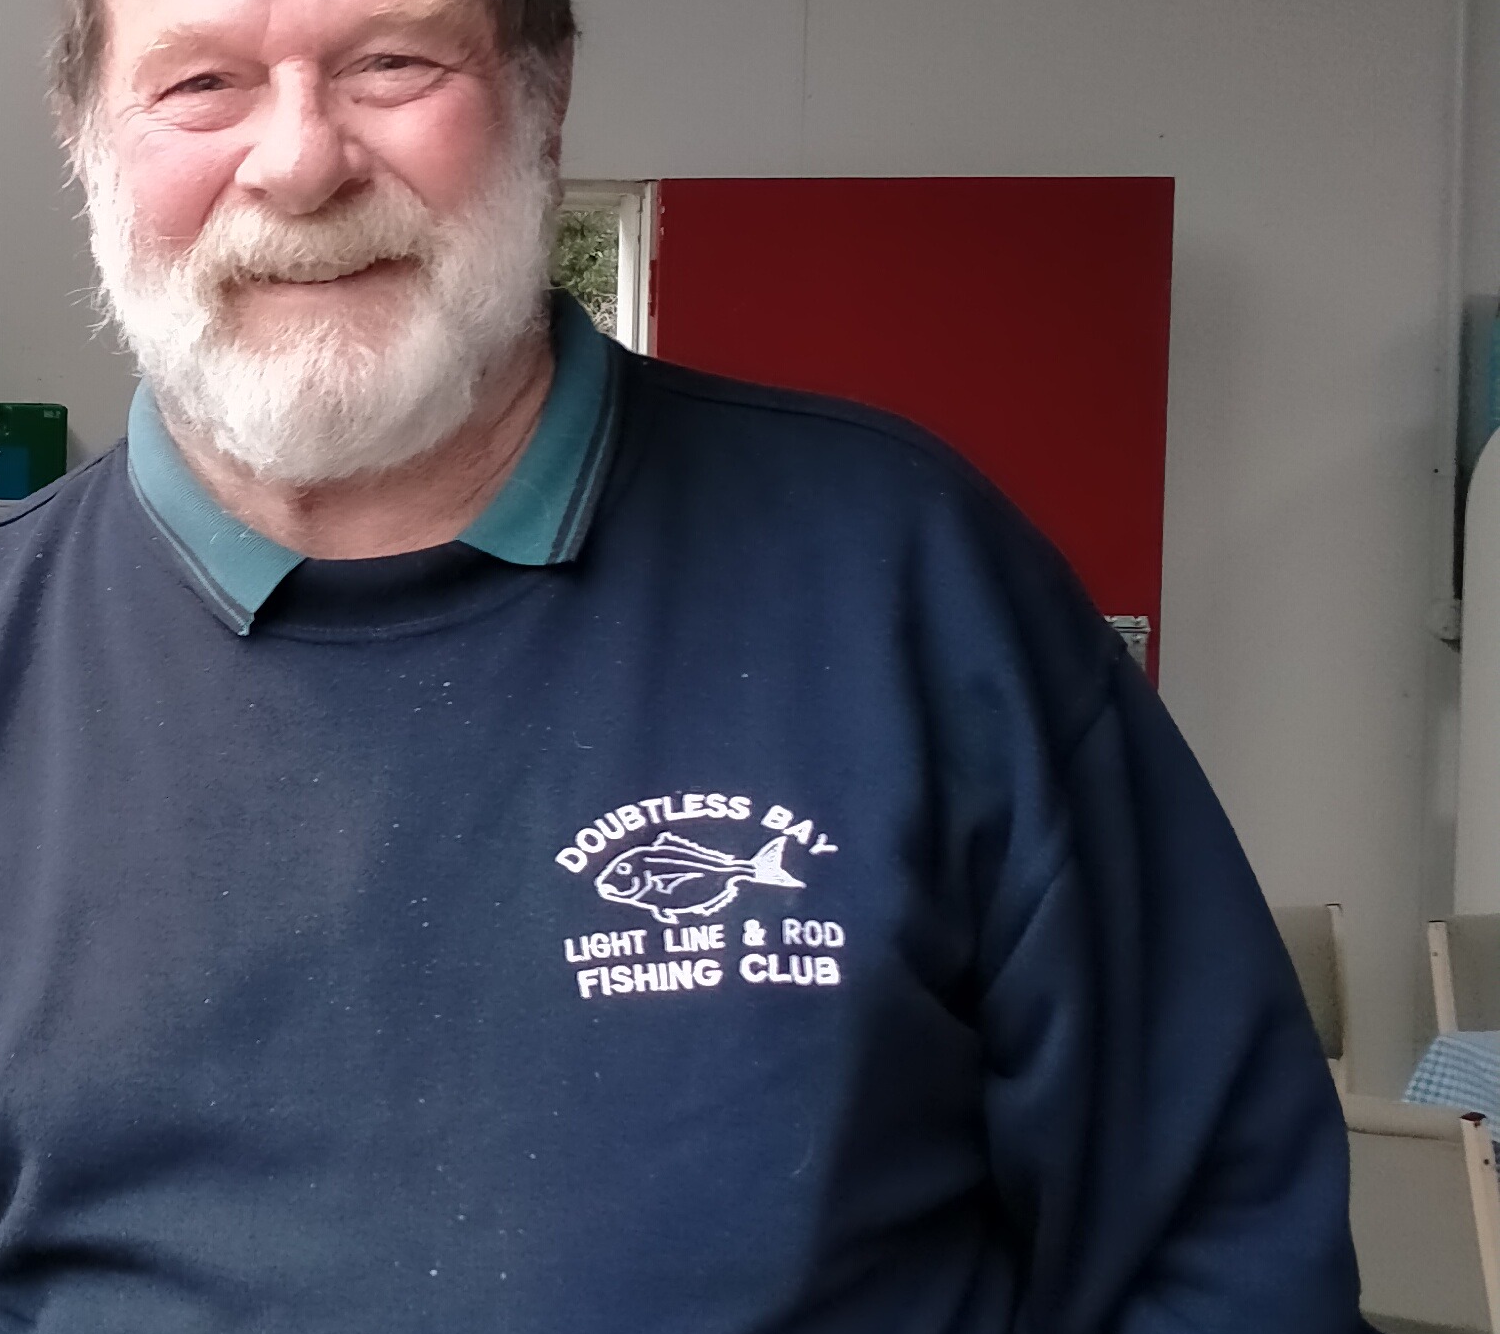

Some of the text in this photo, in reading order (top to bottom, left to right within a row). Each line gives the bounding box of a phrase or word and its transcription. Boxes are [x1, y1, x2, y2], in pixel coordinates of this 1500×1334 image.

[555, 793, 839, 874] DOUBTLESS BAY
[563, 917, 846, 963] LIGHT LINE & ROD
[576, 953, 842, 1000] FISHING CLUB
